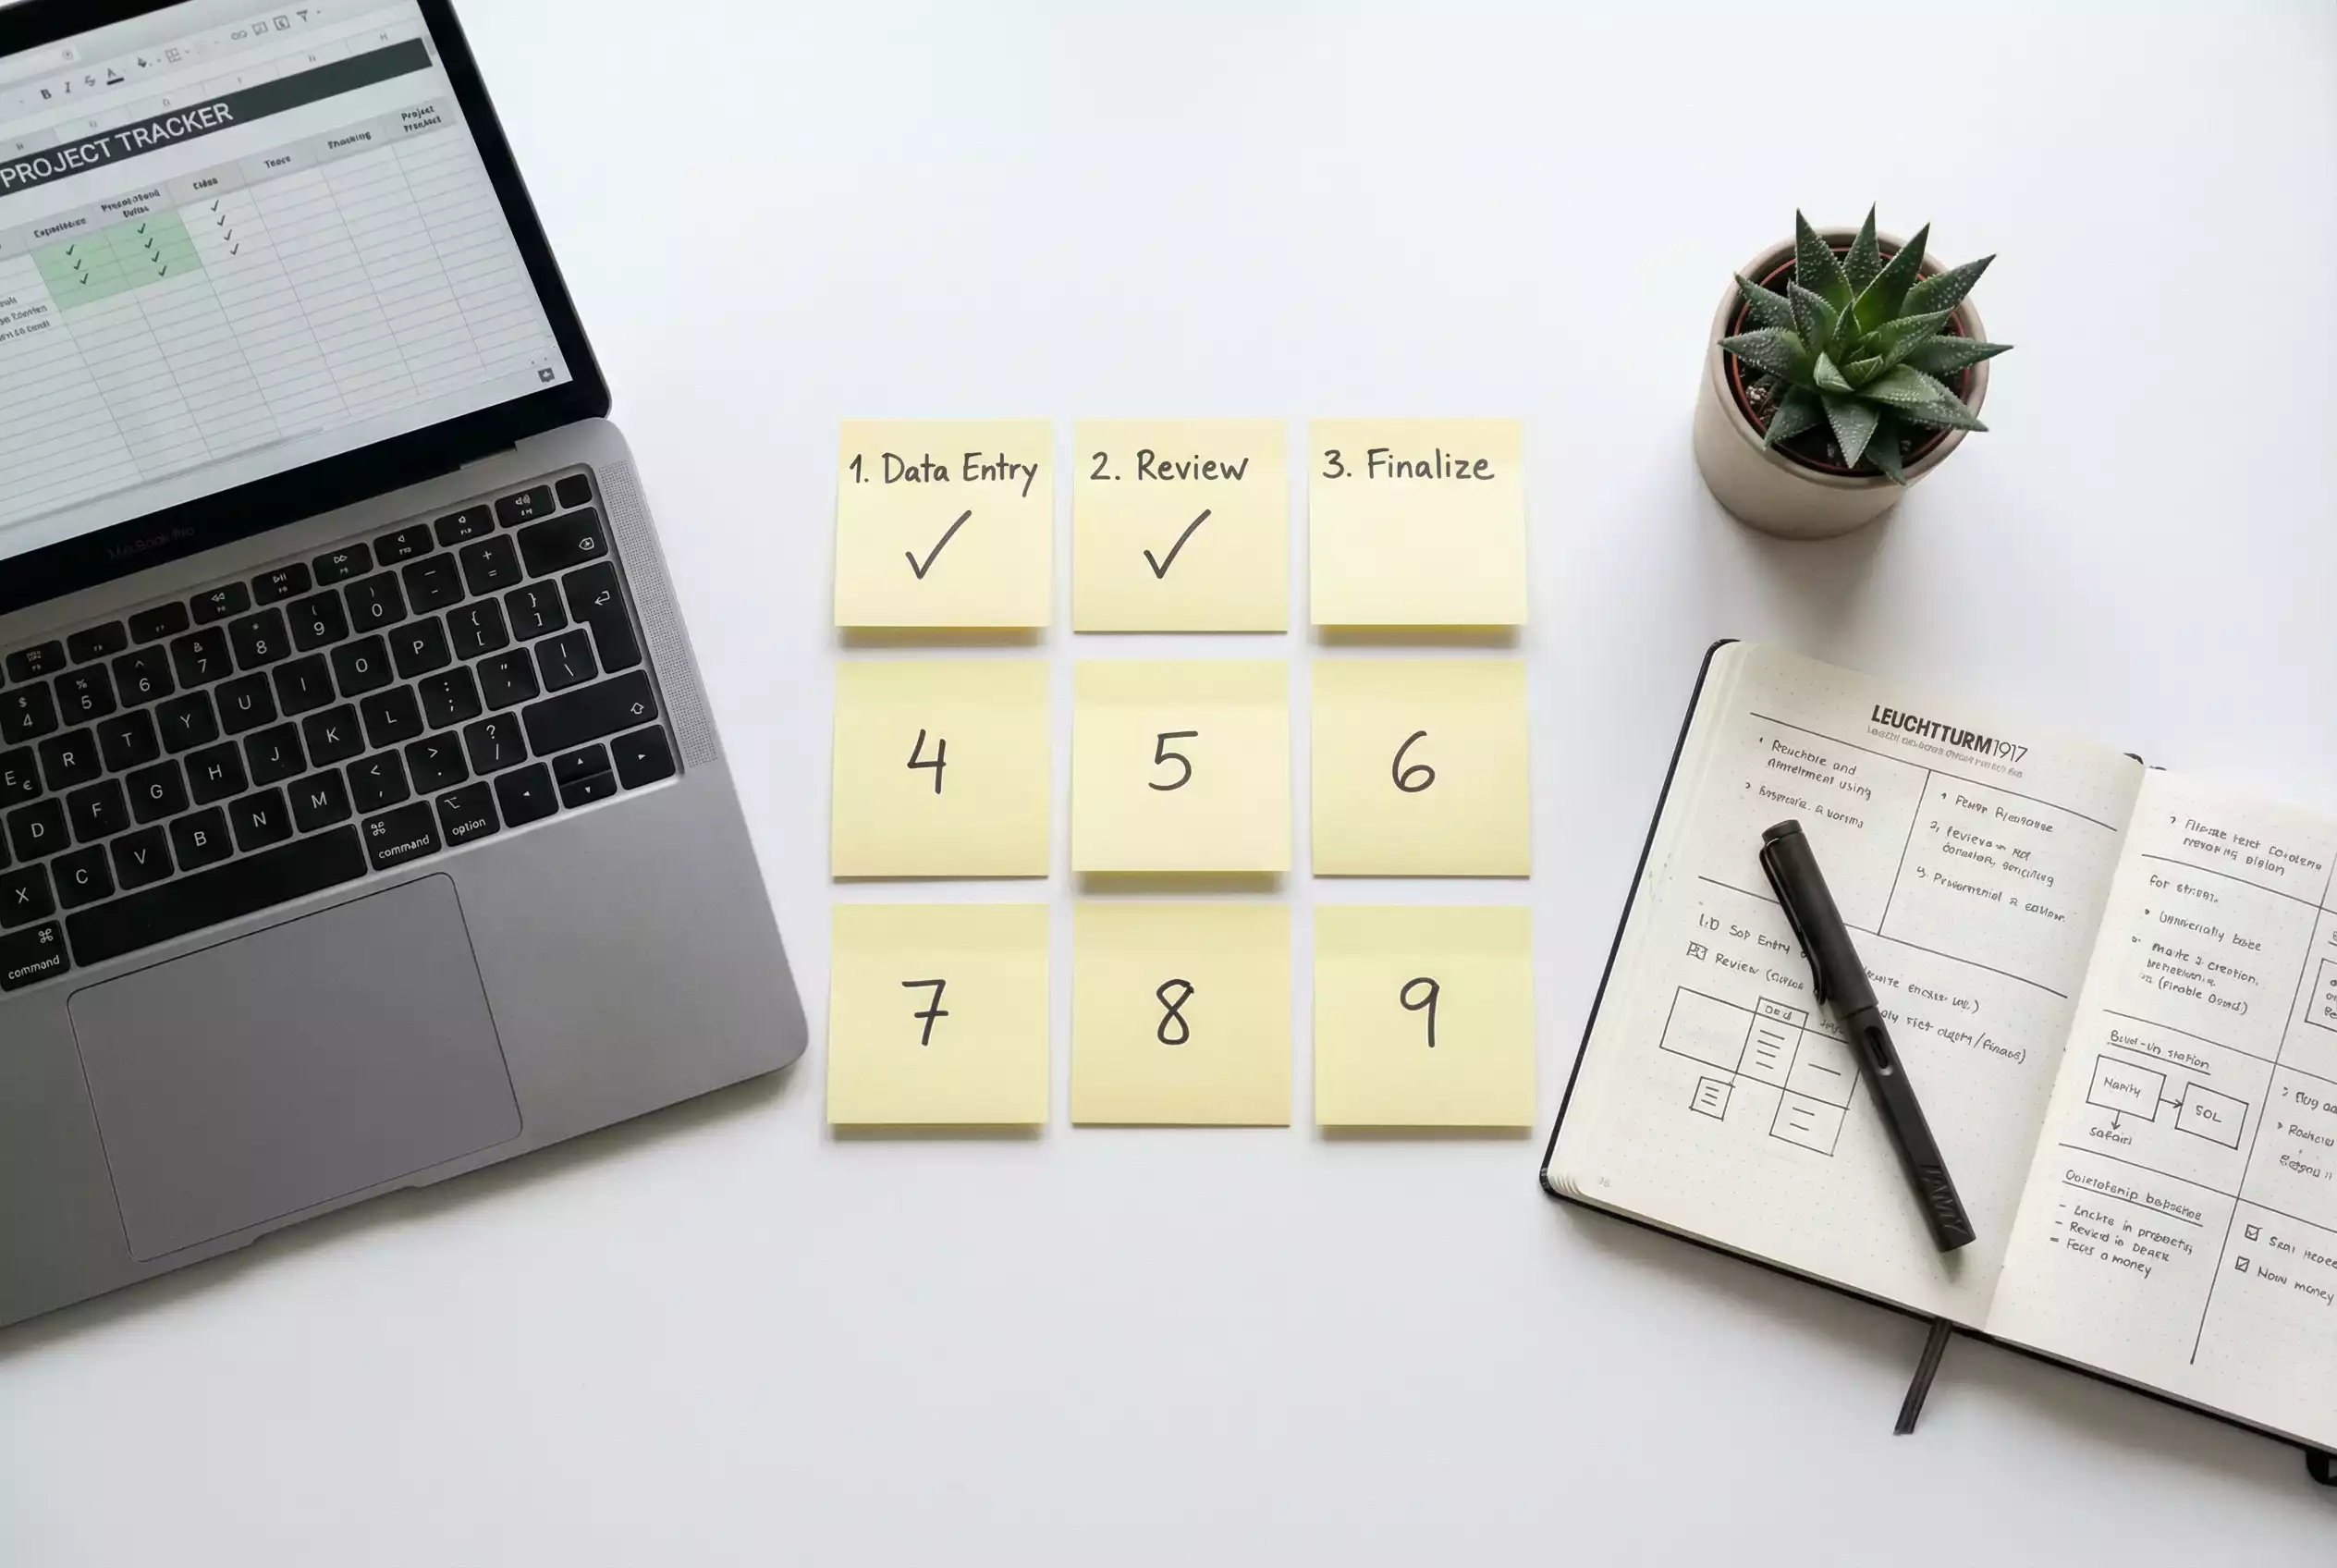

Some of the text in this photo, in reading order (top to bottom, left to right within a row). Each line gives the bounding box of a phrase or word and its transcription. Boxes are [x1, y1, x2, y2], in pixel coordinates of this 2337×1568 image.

[0, 102, 234, 189] PROJECT TRACKER
[1090, 448, 1249, 482] 2. Review
[1322, 447, 1496, 481] 3. Finalize
[849, 451, 1038, 497] 1. Data Entry
[313, 621, 324, 636] 9
[255, 640, 267, 655] 8
[412, 640, 425, 655] P
[198, 658, 207, 673] 7
[139, 678, 150, 692] 6
[81, 695, 92, 710] 5
[238, 694, 251, 710] U
[22, 714, 33, 728] 4
[179, 714, 191, 729] Y
[385, 710, 398, 724] L
[122, 732, 133, 747] T
[325, 727, 340, 743] K
[1870, 704, 2028, 763] LEUCHTTURM1917
[63, 753, 76, 767] R
[271, 746, 279, 762] J
[907, 729, 947, 795] 4
[1148, 729, 1199, 791] 5
[1391, 730, 1436, 793] 6
[5, 770, 17, 786] E
[208, 764, 222, 780] H
[150, 784, 163, 799] G
[311, 791, 327, 808] M
[92, 802, 102, 817] F
[252, 812, 267, 827] N
[452, 817, 486, 837] option
[31, 823, 44, 838] D
[194, 831, 207, 847] B
[378, 834, 430, 859] command
[134, 849, 146, 864] V
[76, 869, 89, 884] C
[15, 888, 30, 904] X
[8, 955, 60, 980] command
[901, 978, 948, 1047] 7
[1156, 978, 1195, 1046] 8
[1400, 976, 1440, 1048] 9
